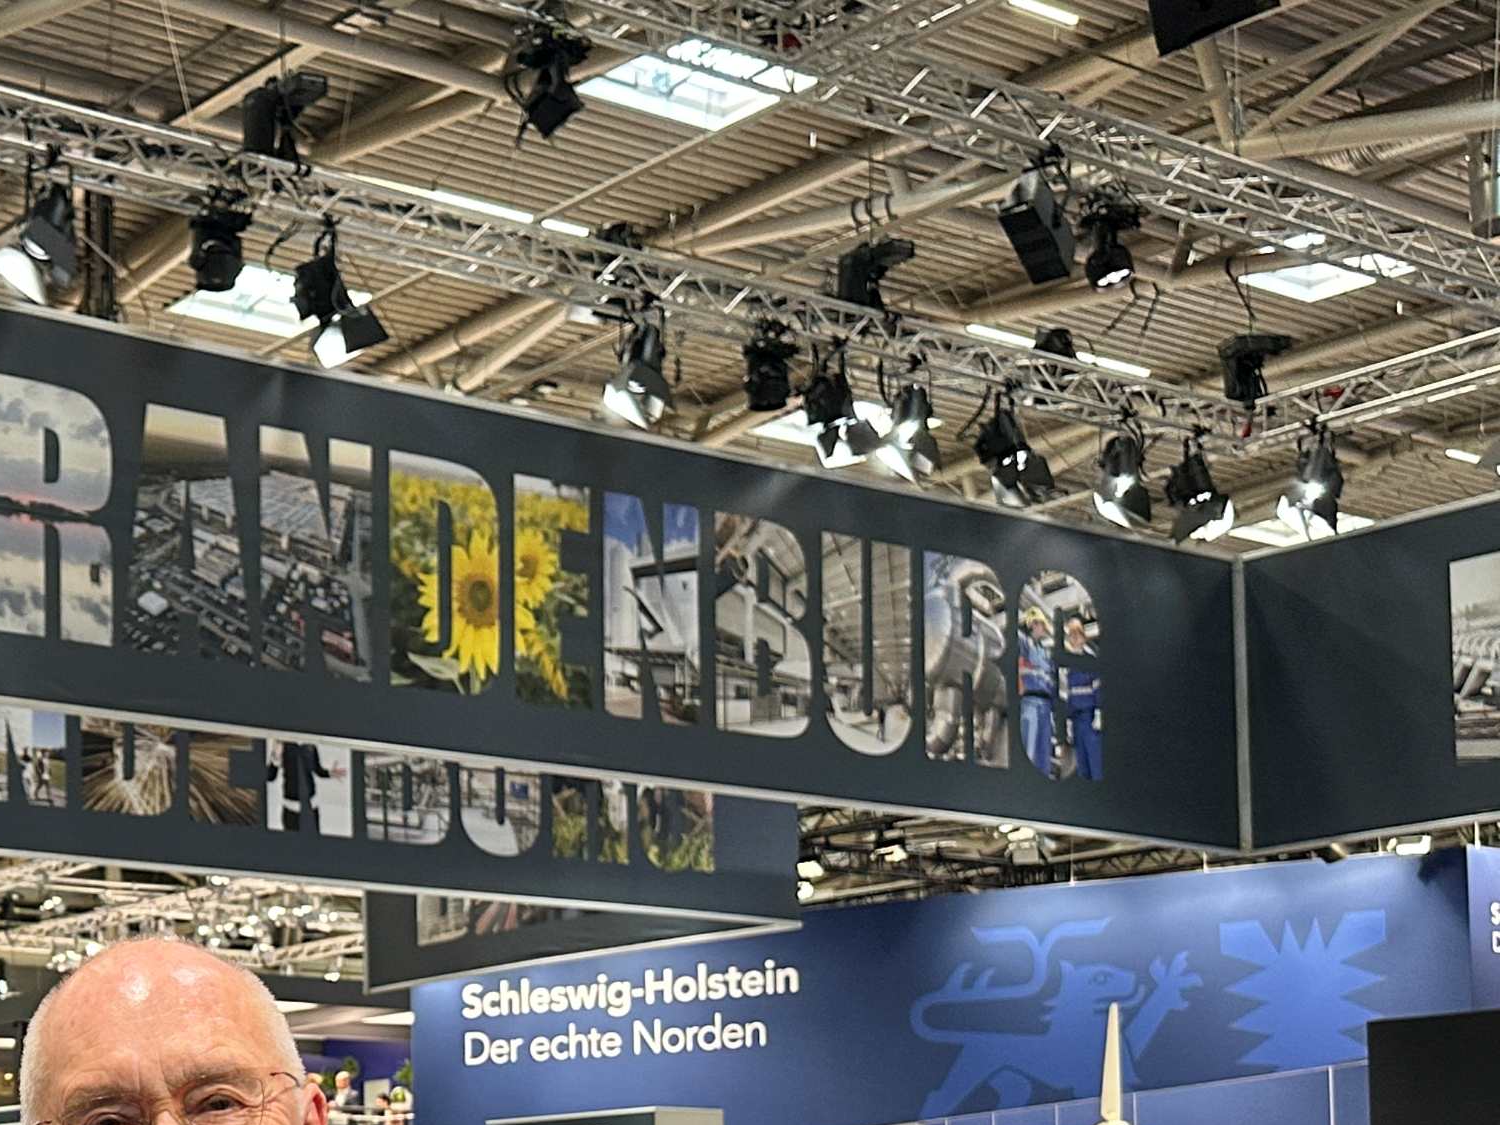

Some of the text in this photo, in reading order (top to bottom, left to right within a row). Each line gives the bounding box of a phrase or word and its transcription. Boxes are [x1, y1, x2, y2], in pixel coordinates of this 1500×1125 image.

[461, 960, 800, 1020] Schleswig-Holstein
[464, 1012, 768, 1066] Der echte Norden
